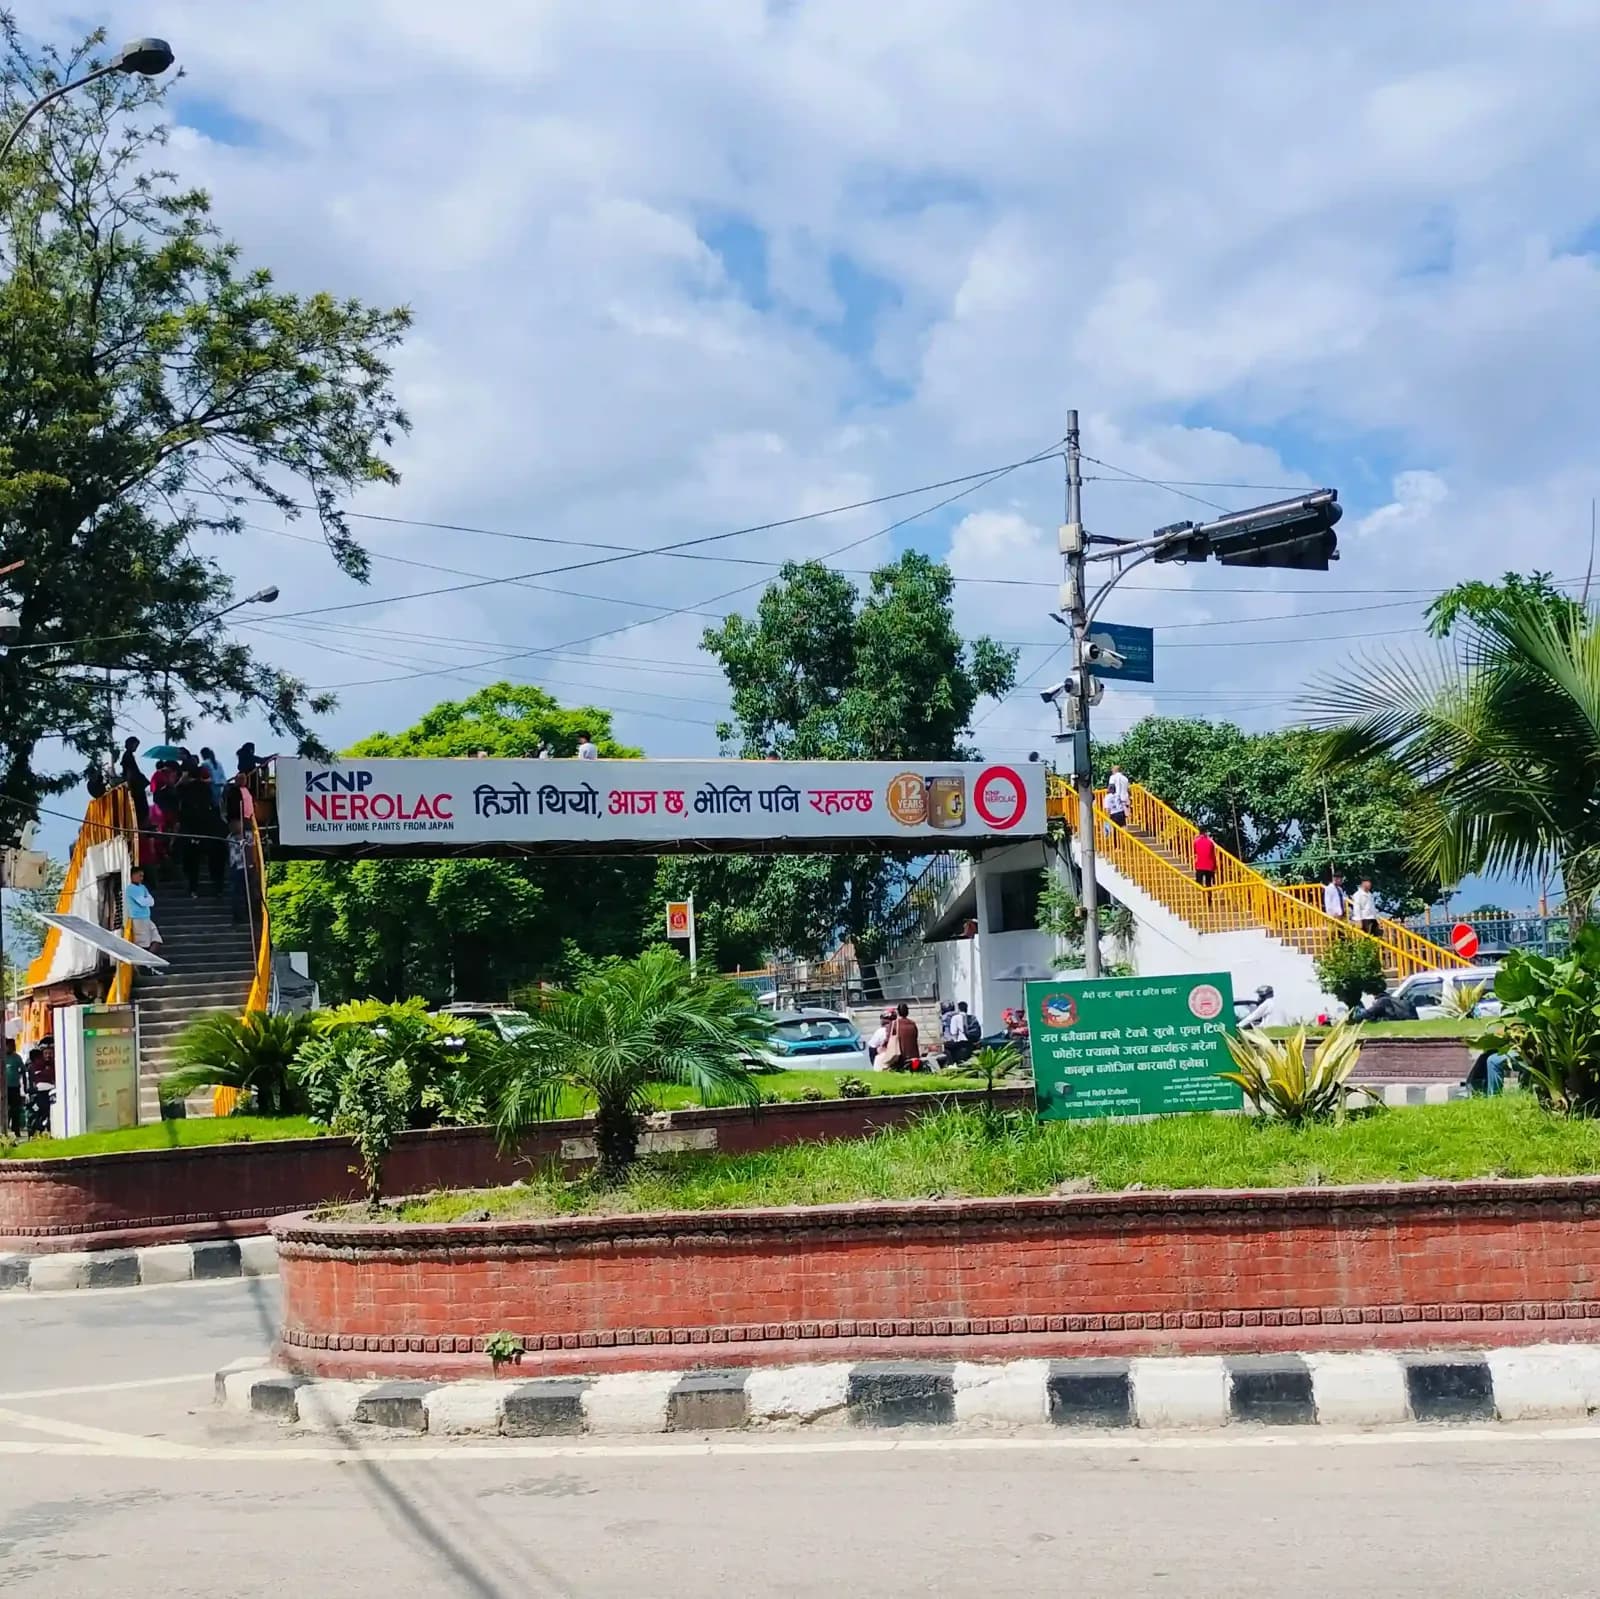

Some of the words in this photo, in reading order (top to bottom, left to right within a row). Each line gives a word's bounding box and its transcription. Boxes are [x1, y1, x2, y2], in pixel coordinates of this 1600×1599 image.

[305, 771, 373, 793] KNP
[898, 780, 921, 800] 12
[473, 781, 531, 818] हिजो
[537, 781, 603, 819] थियो,
[608, 789, 658, 815] आज
[663, 789, 688, 818] छ,
[694, 782, 752, 814] भोलि
[758, 784, 801, 813] पनि
[808, 789, 874, 816] रहन्छ
[897, 800, 924, 809] YEARS
[985, 795, 1016, 803] NEROLAC
[304, 793, 454, 821] NEROLAC
[305, 822, 343, 832] HEALTHY
[345, 822, 370, 832] HOME
[372, 821, 401, 831] PAINTS
[403, 821, 427, 831] FROM
[428, 820, 454, 831] JAPAN
[1040, 1033, 1058, 1043] यस
[1052, 1047, 1083, 1059] फोहोर
